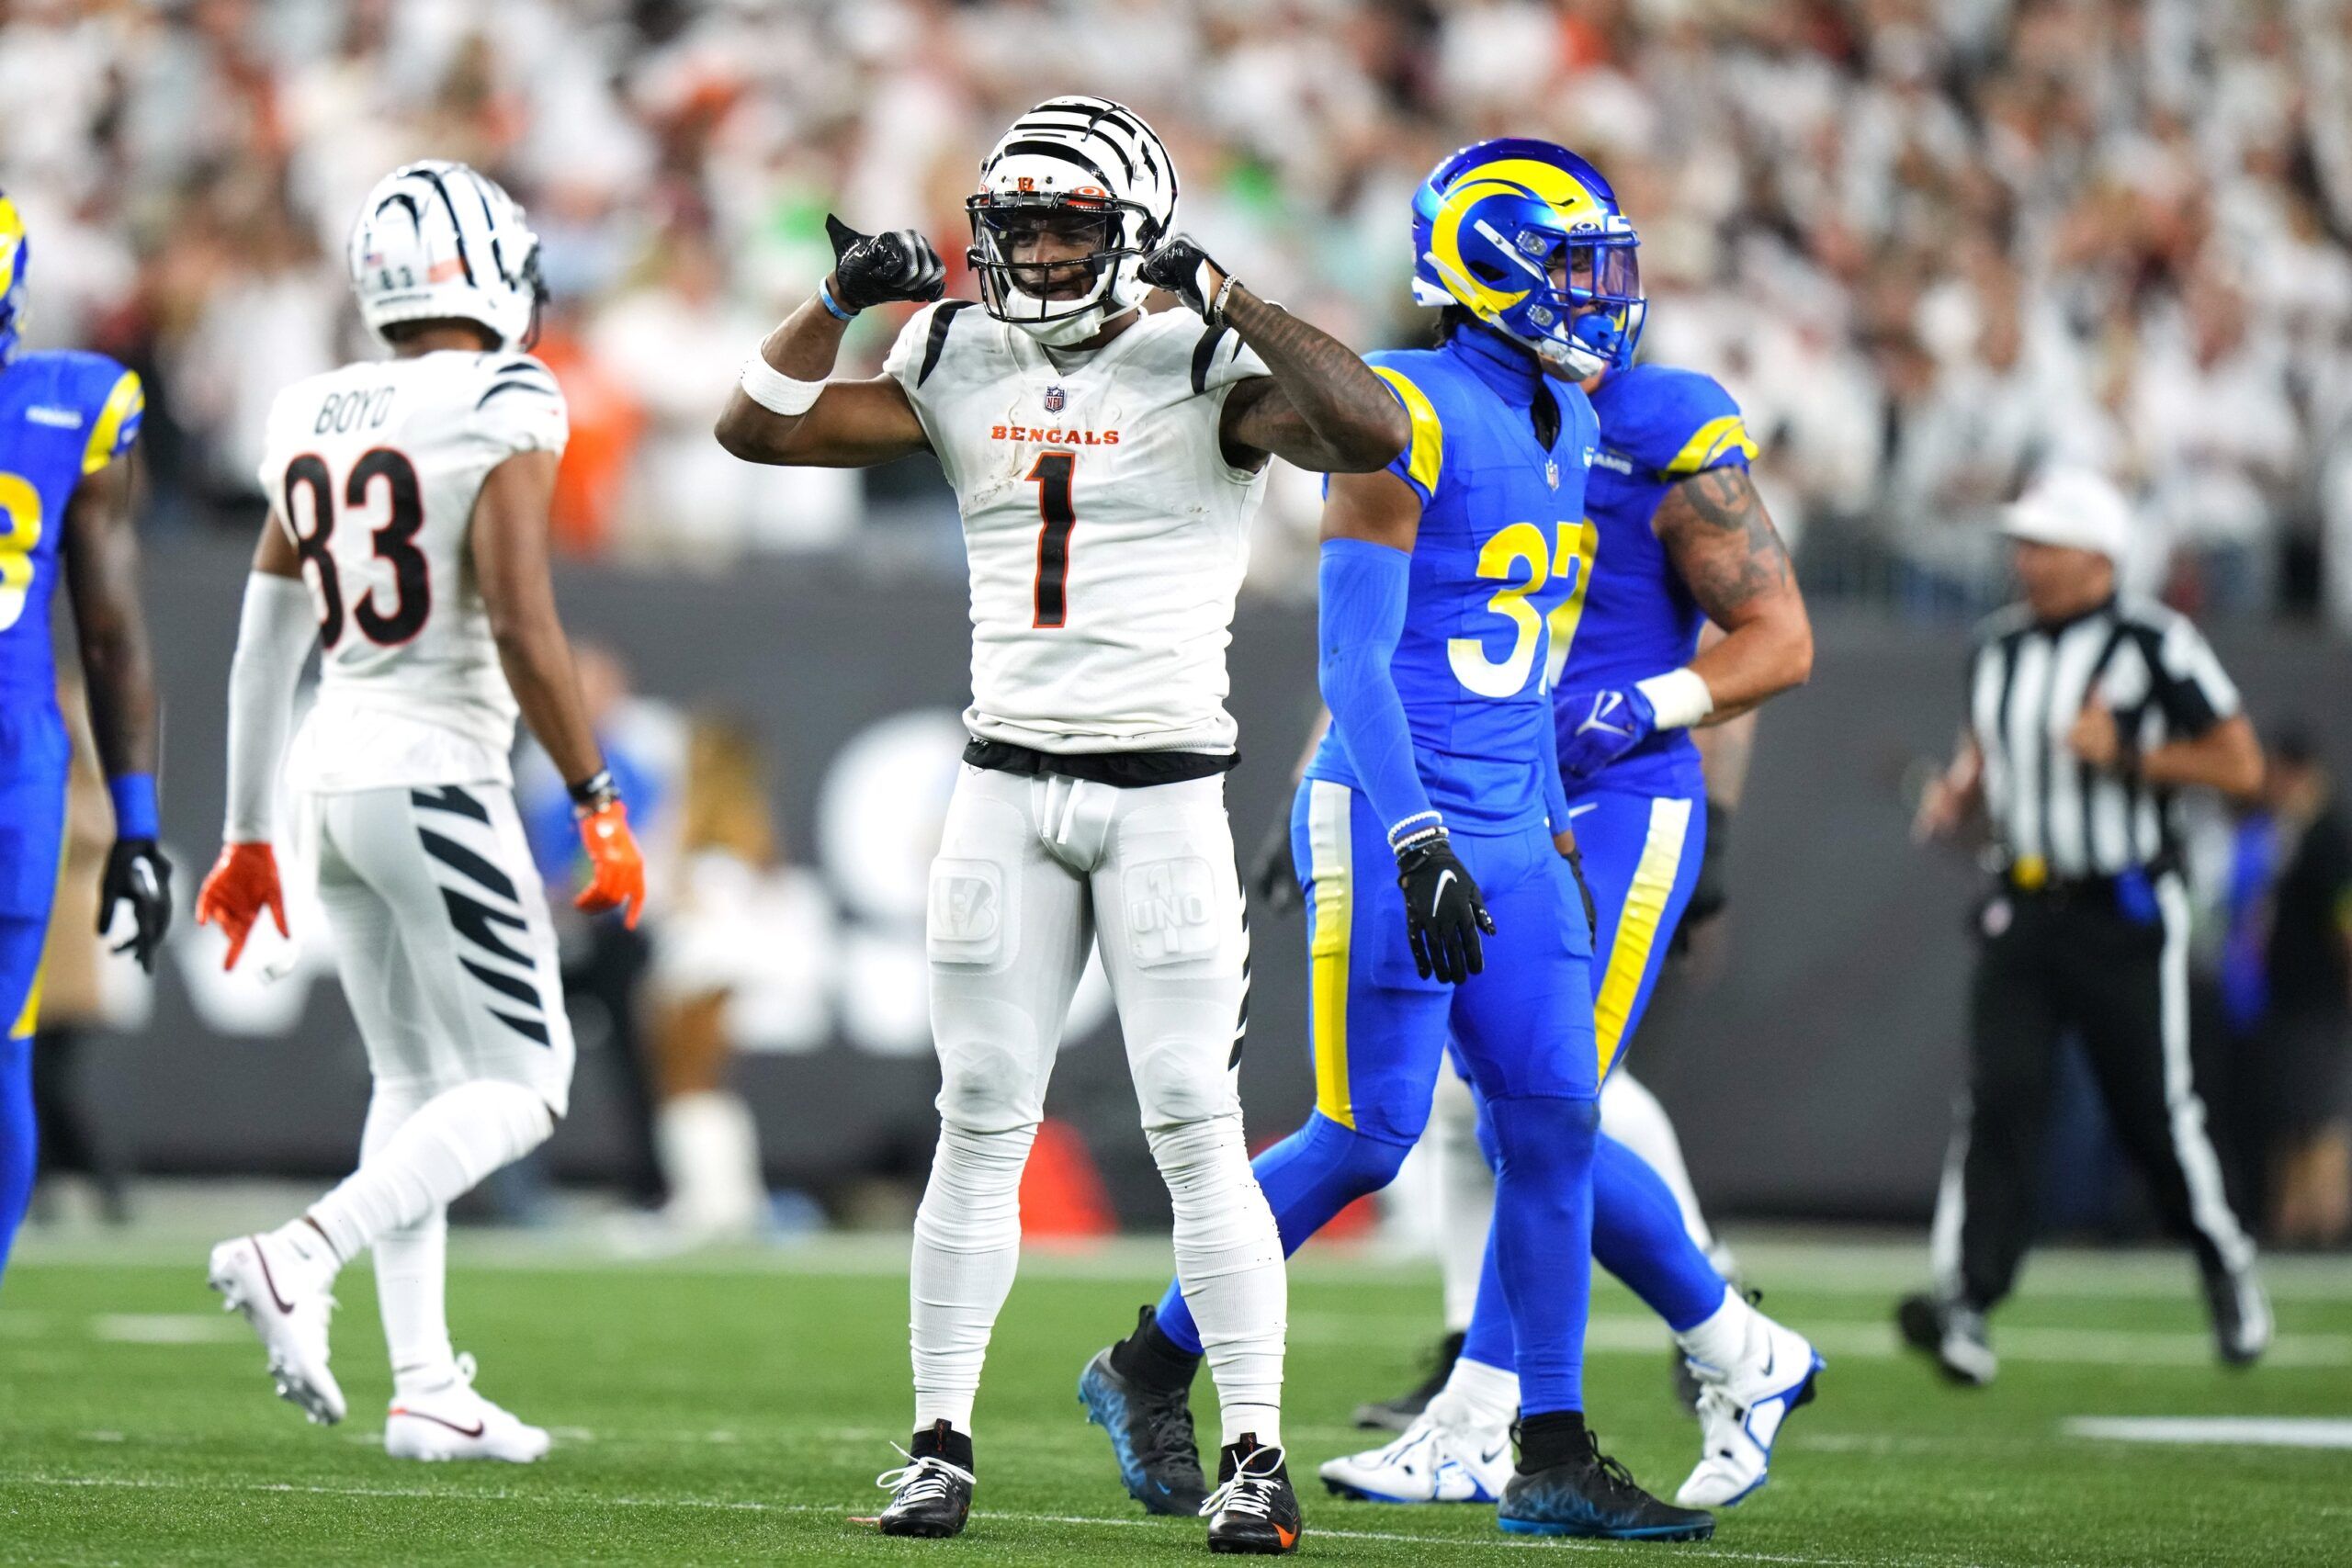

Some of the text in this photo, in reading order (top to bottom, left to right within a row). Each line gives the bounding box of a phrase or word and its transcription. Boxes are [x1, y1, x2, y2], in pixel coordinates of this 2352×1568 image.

[314, 385, 395, 435] BOYD
[991, 425, 1120, 446] BENGALS
[283, 446, 431, 650] 83
[1024, 452, 1076, 628] 1
[1131, 892, 1211, 933] UNO
